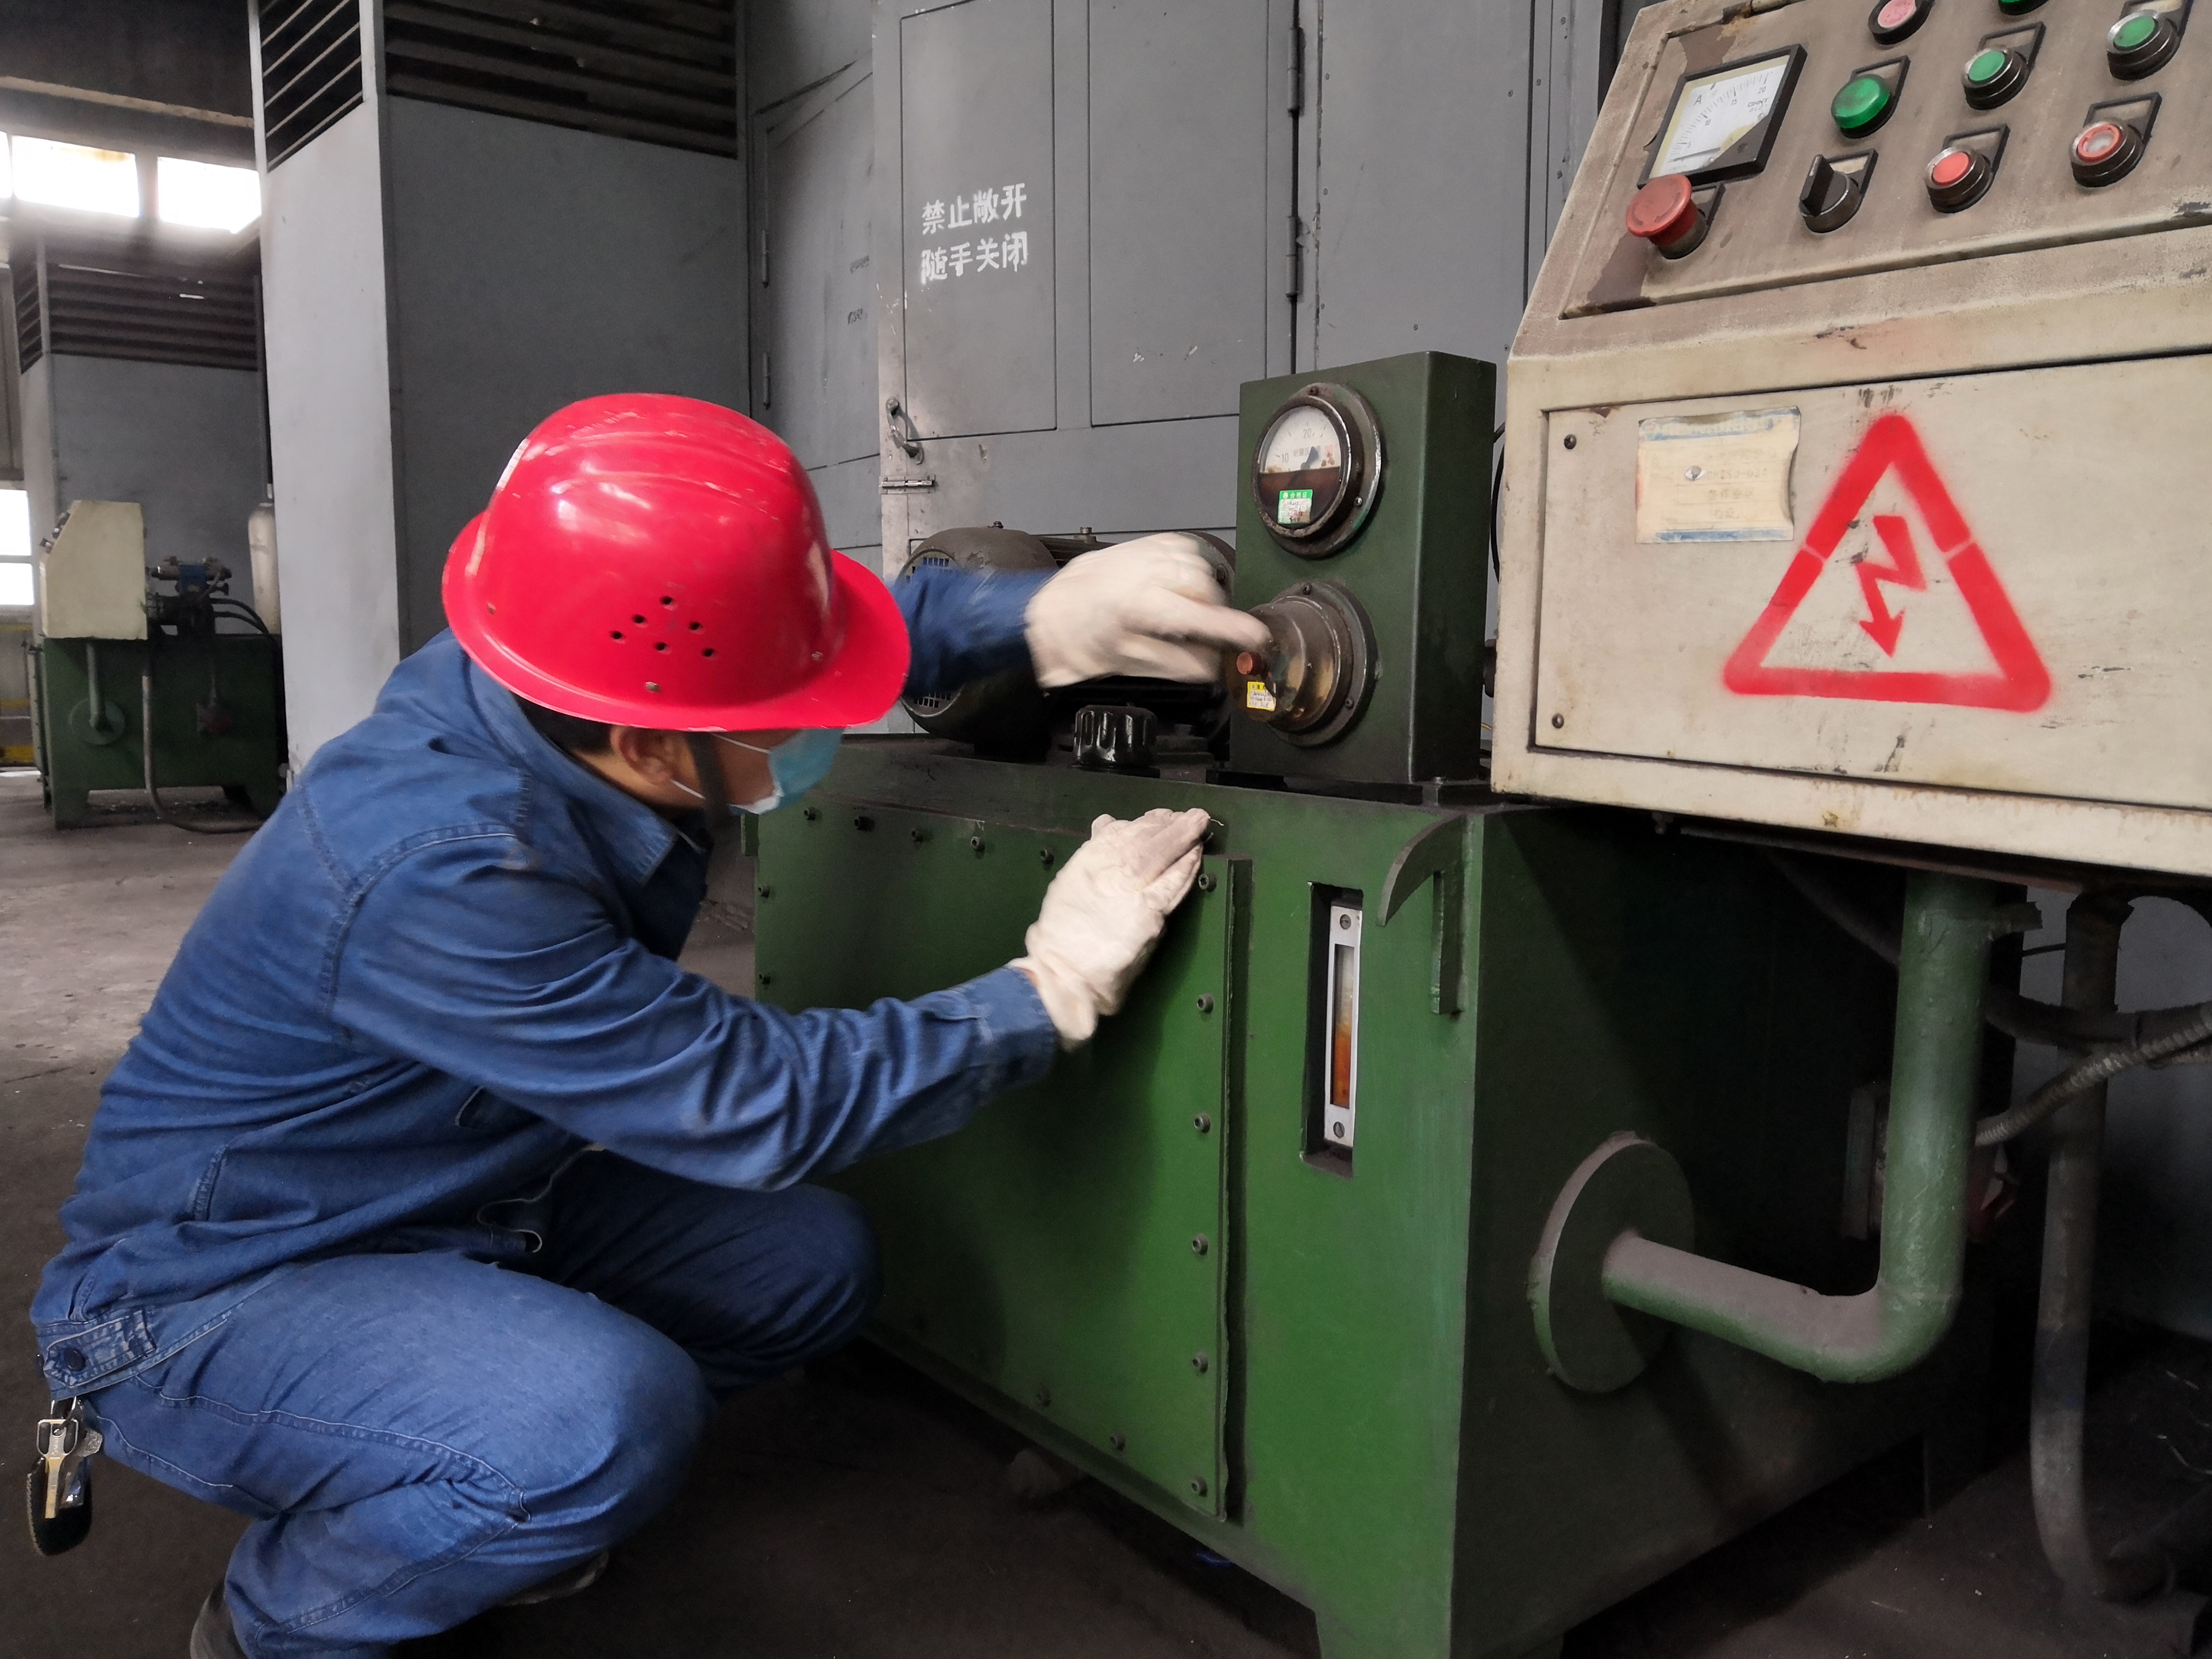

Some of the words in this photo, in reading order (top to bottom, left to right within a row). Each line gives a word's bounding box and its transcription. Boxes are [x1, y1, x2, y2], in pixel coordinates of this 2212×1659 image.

[1757, 86, 1767, 94] 20
[1694, 95, 1702, 106] A
[922, 182, 1027, 235] 禁止敞开
[921, 231, 1028, 285] 随手关闭
[1303, 428, 1312, 439] 20
[1282, 453, 1289, 463] 10
